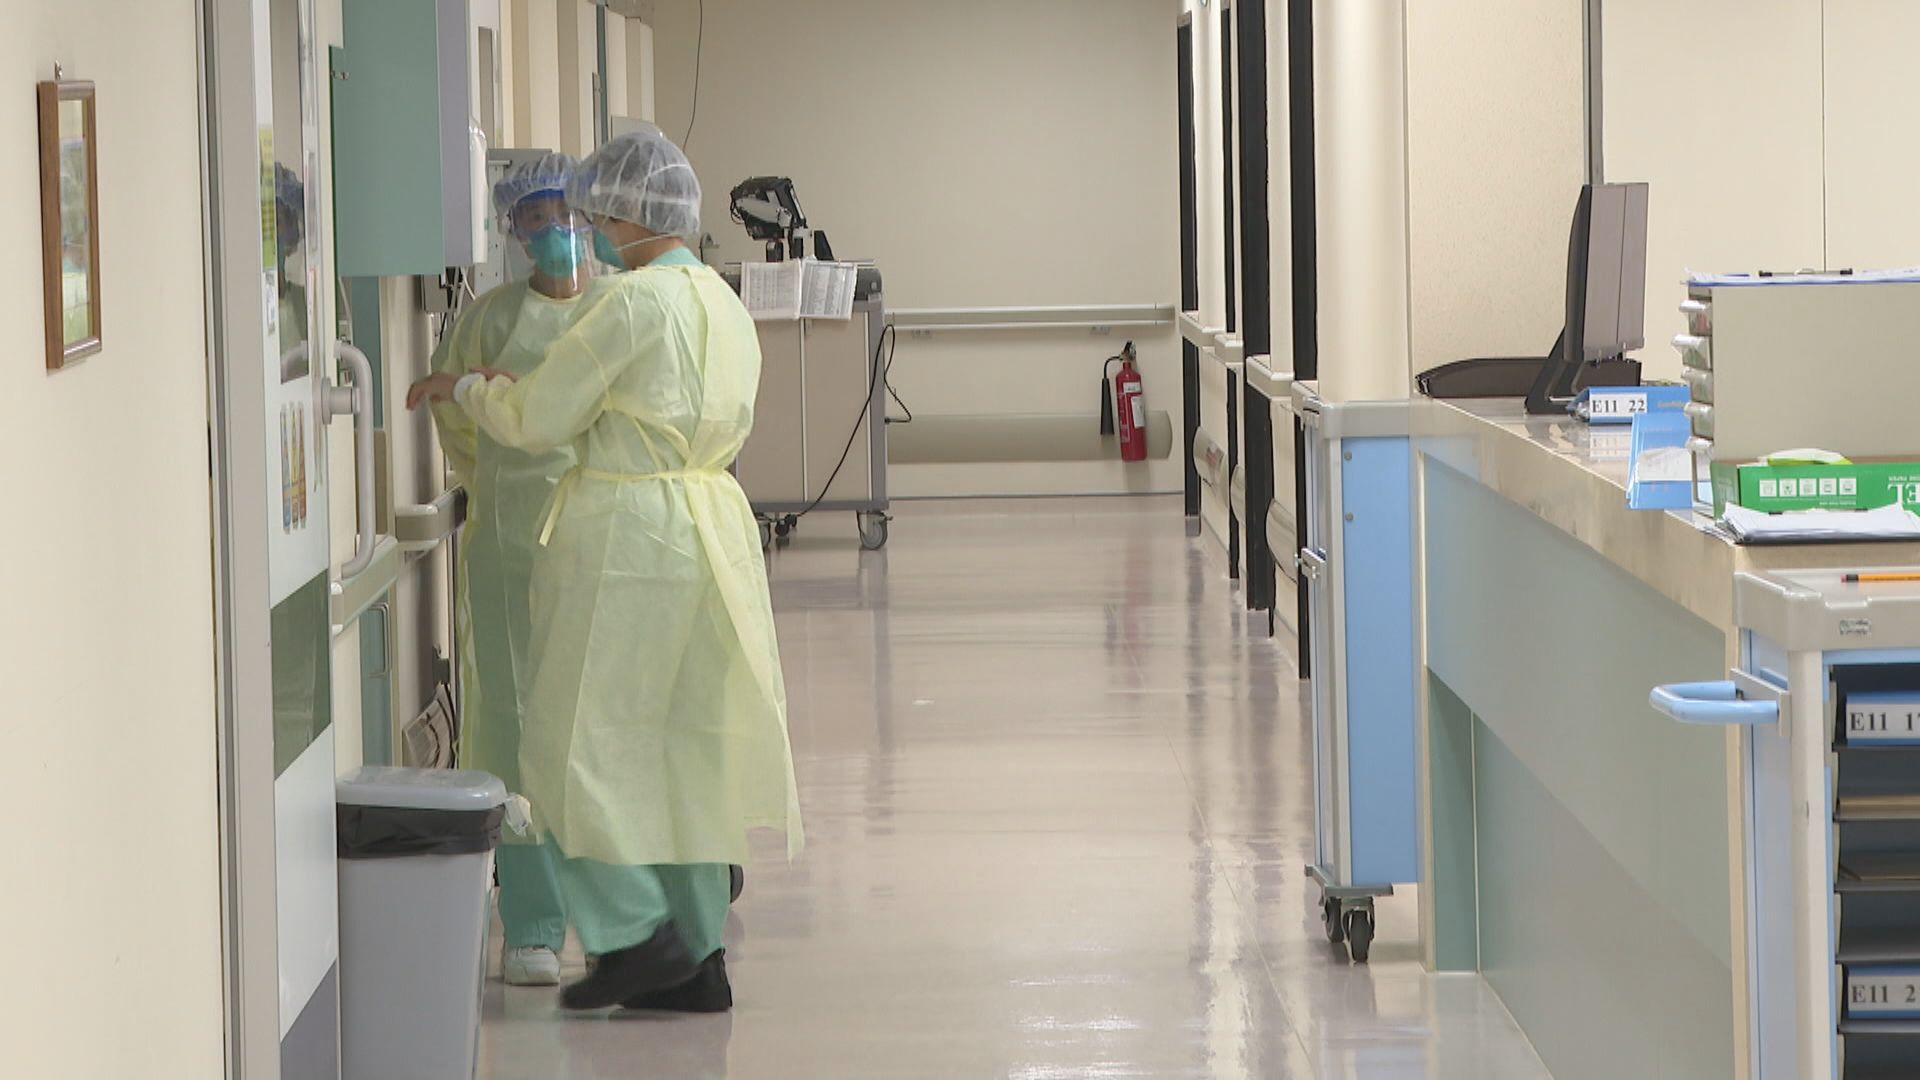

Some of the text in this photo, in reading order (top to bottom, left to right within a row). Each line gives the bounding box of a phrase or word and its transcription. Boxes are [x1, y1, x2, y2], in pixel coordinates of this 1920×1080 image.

[1592, 399, 1617, 413] E11
[1628, 399, 1646, 412] 22
[1849, 711, 1920, 731] E11 1
[1851, 984, 1889, 1003] E11
